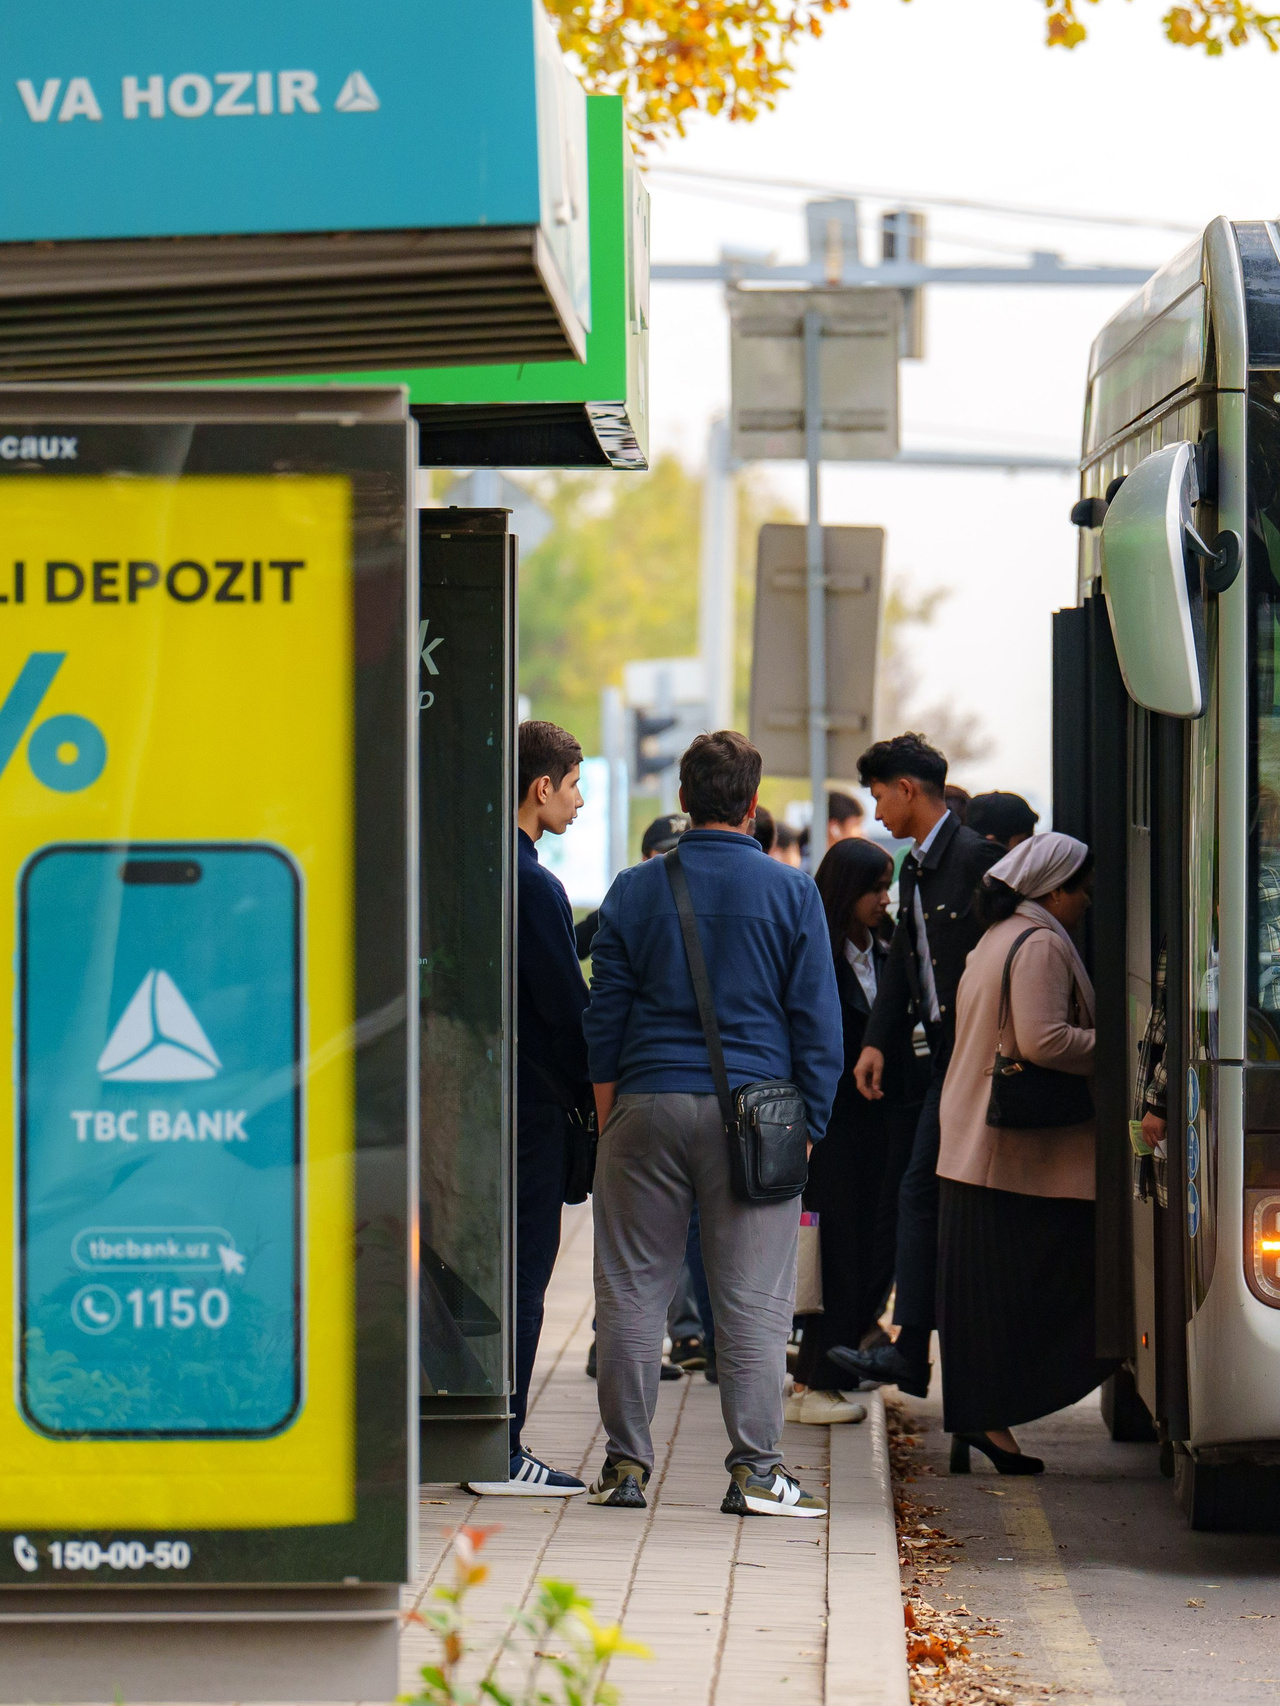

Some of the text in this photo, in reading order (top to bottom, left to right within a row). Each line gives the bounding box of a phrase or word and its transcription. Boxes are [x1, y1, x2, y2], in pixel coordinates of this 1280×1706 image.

[15, 69, 322, 123] VA HOZIR
[46, 560, 306, 604] DEPOZIT
[70, 1109, 249, 1142] TBC BANK
[89, 1238, 211, 1259] tbcbank.uz
[126, 1287, 230, 1329] 1150
[47, 1540, 192, 1571] 150-00-50
